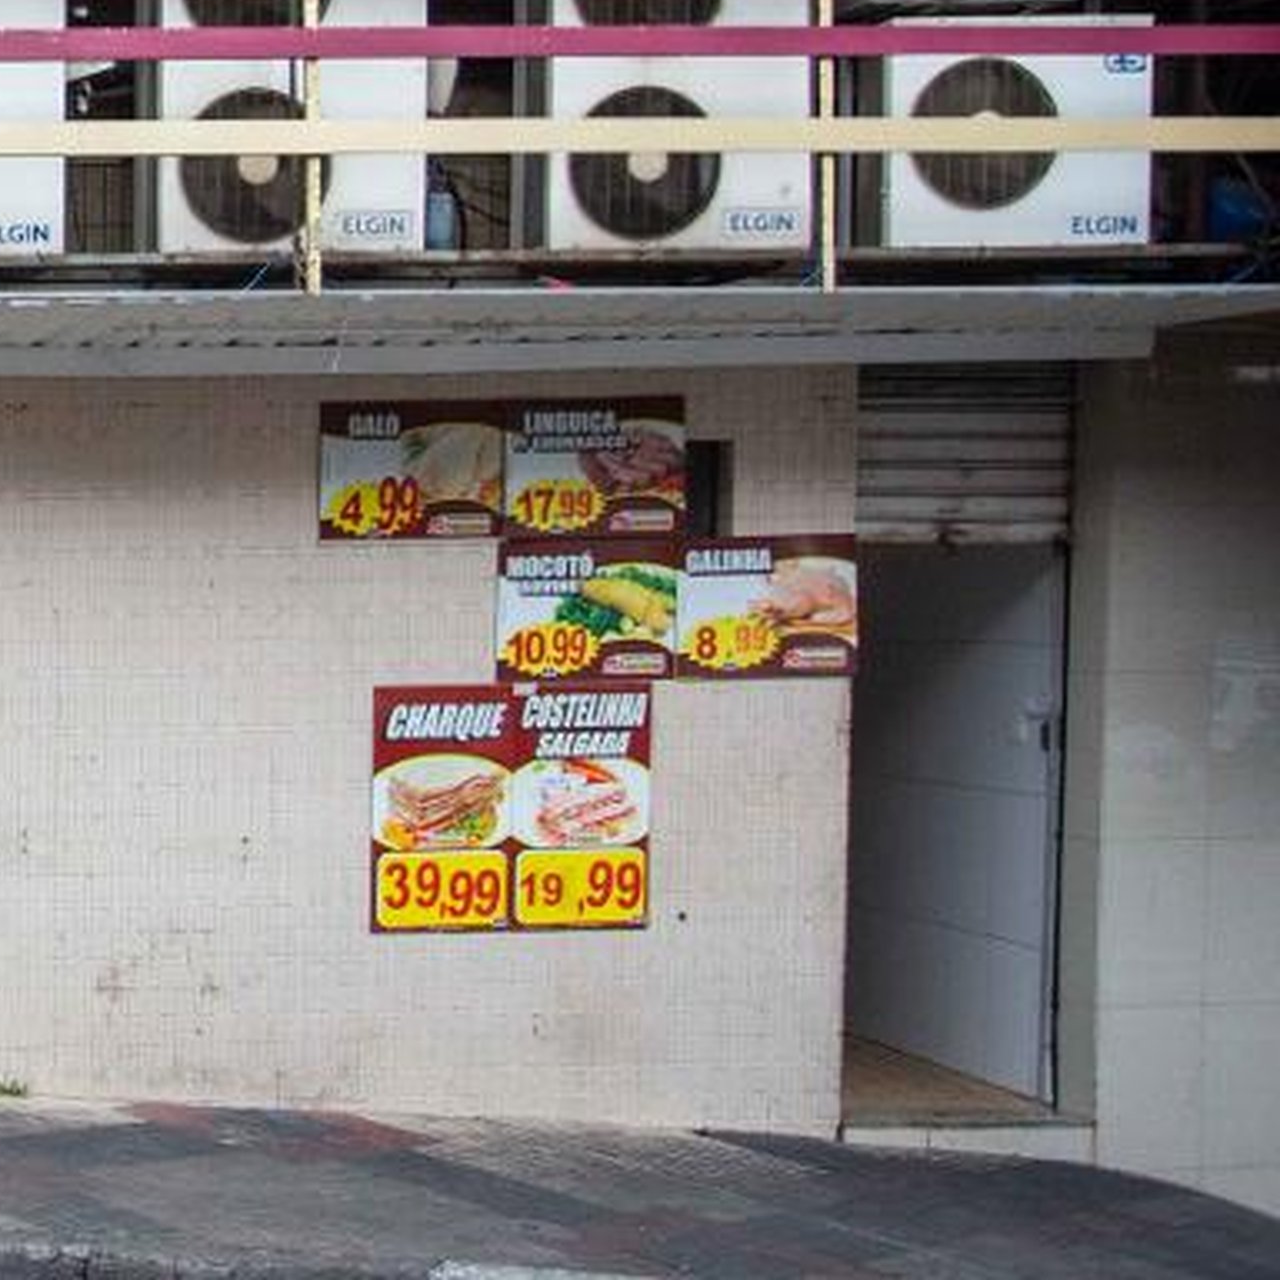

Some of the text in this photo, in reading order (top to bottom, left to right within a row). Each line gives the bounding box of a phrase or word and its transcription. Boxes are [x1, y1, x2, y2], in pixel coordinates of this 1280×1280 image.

[342, 216, 405, 235] ELGIN
[729, 215, 794, 232] ELGIN
[1070, 216, 1138, 235] ELGIN
[522, 693, 648, 729] COSTELINHA
[386, 703, 507, 741] CHARQUE
